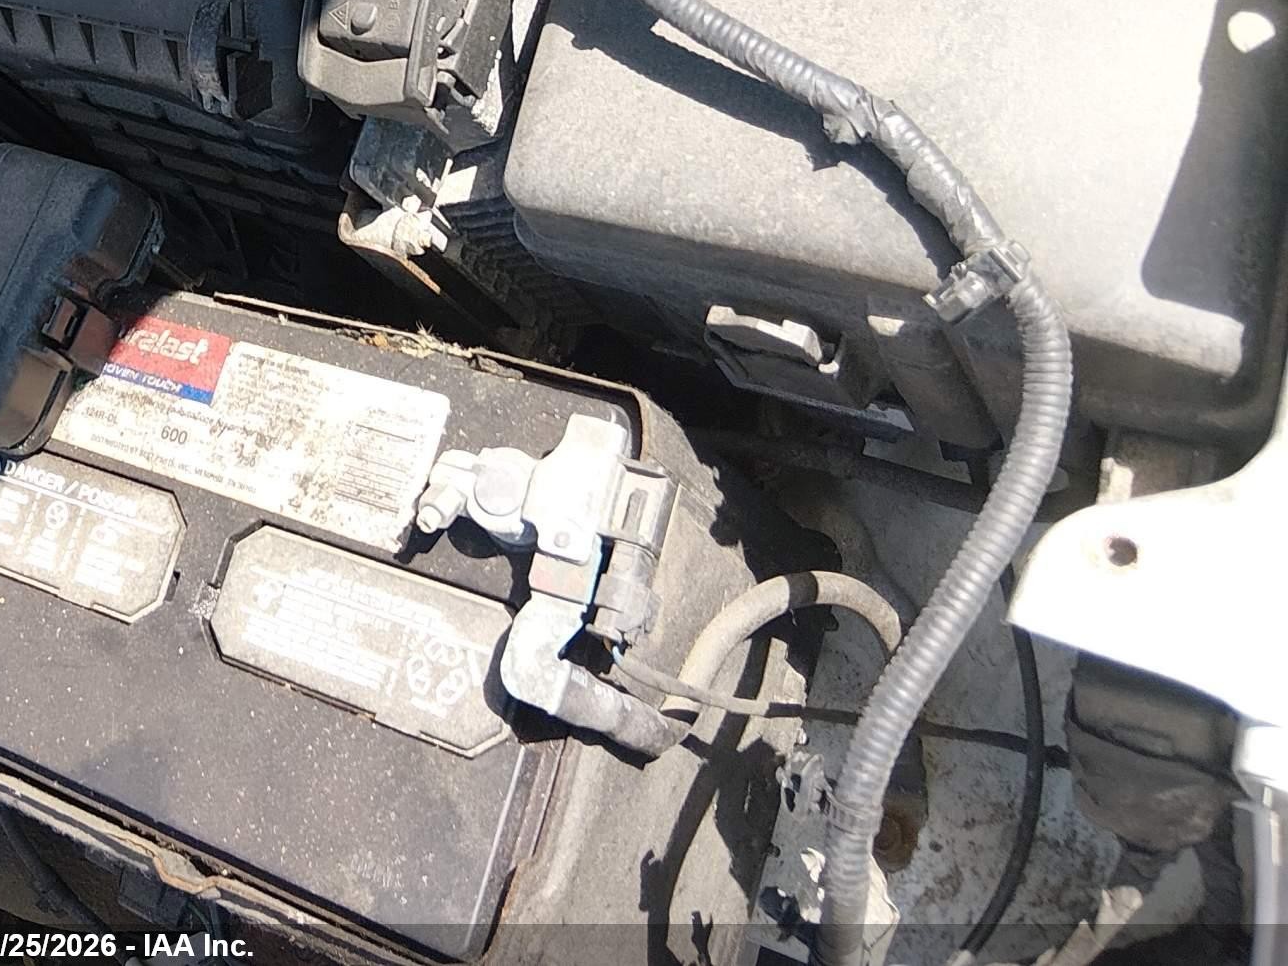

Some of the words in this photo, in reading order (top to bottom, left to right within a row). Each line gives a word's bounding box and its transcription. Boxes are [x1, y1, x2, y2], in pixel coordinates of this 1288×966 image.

[122, 328, 209, 365] ralast
[103, 362, 139, 381] OVEN
[160, 425, 188, 445] 600
[4, 459, 66, 494] DANGER
[76, 484, 138, 518] POISON
